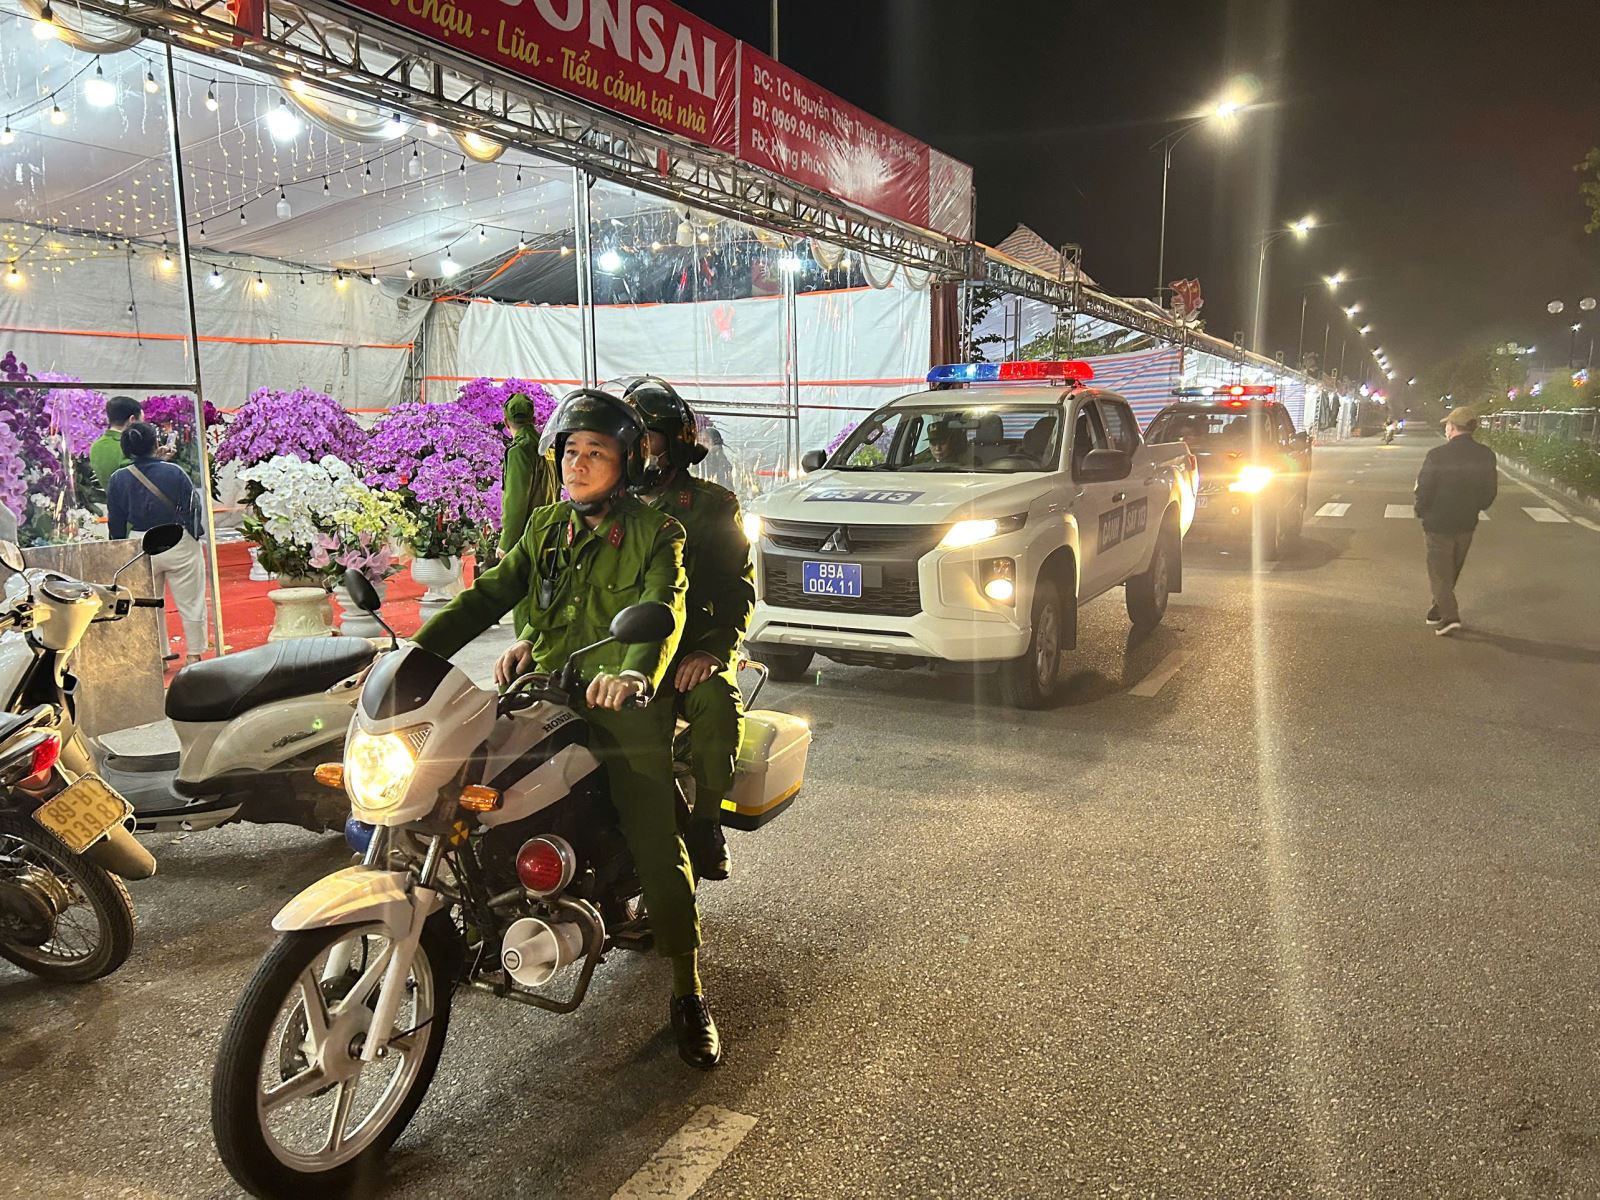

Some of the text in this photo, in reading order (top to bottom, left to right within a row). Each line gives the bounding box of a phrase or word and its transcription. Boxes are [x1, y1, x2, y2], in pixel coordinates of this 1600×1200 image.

[501, 0, 717, 101] NSAI
[497, 19, 540, 67] Lũa
[560, 47, 599, 91] Tiểu
[603, 70, 648, 110] cảnh
[651, 90, 673, 124] tại
[676, 105, 706, 135] nhà
[753, 64, 773, 93] ĐC:
[776, 76, 791, 101] 1C
[752, 96, 769, 122] ĐT:
[863, 491, 912, 502] 113
[819, 564, 844, 579] 89A
[809, 578, 853, 594] 004.11
[542, 712, 575, 732] HONDA
[47, 781, 101, 825] 89-B1
